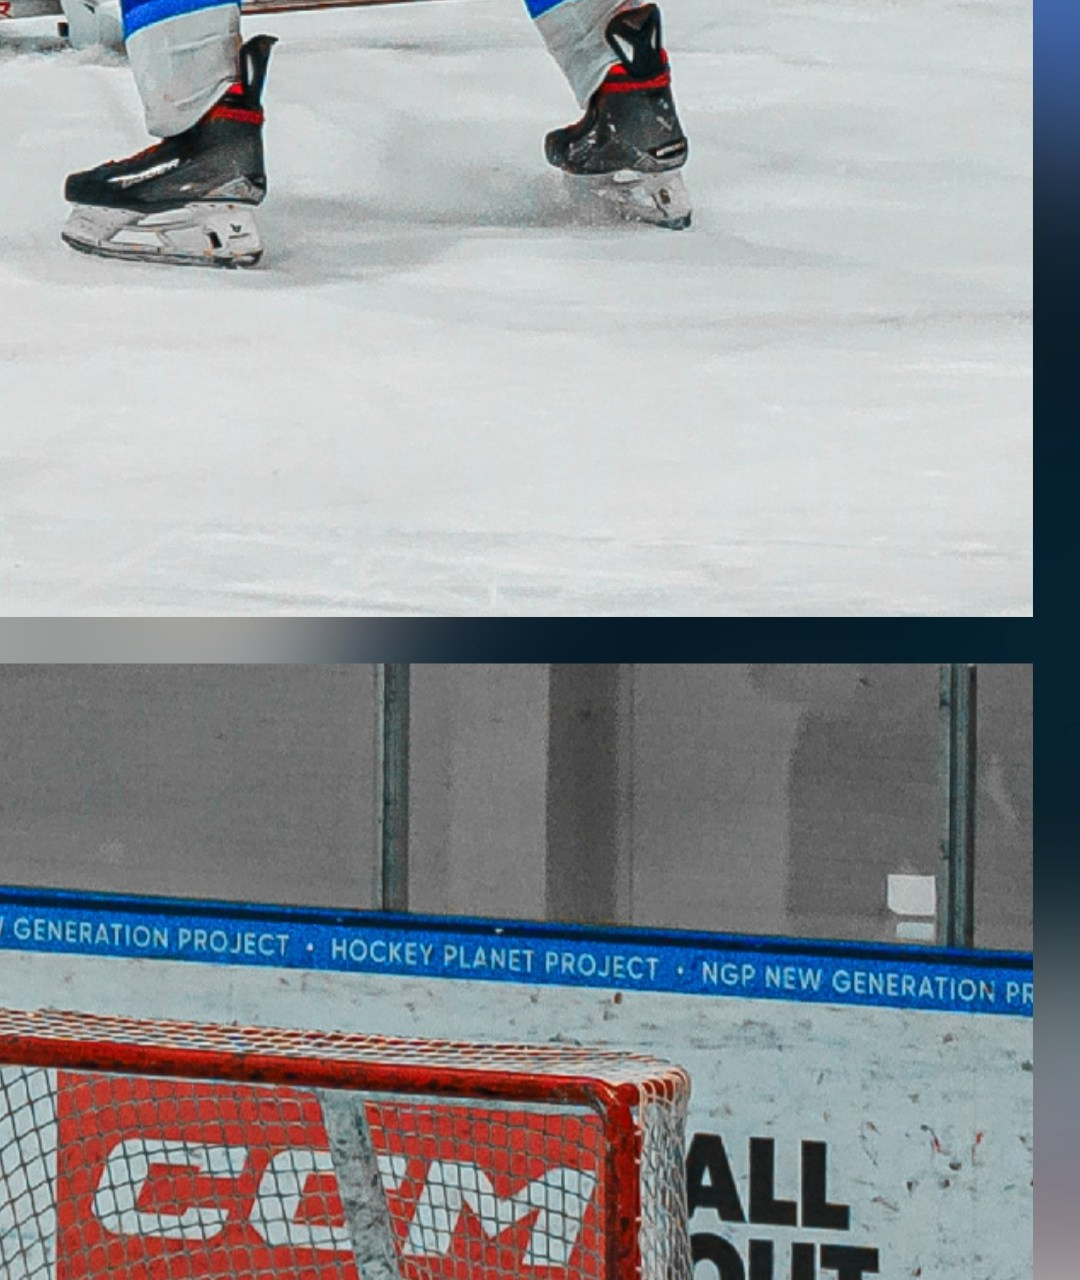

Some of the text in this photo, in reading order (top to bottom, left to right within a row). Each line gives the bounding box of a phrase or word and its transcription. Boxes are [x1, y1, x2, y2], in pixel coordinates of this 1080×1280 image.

[13, 918, 169, 949] GENERATION
[178, 928, 290, 957] PROJECT
[331, 937, 433, 966] HOCKEY
[443, 945, 535, 973] PLANET
[545, 951, 660, 980] PROJECT
[701, 961, 757, 986] NGP
[765, 965, 822, 991] NEW
[832, 970, 996, 1002] GENERATION
[91, 1137, 599, 1265] CCM
[685, 1133, 850, 1231] ALL
